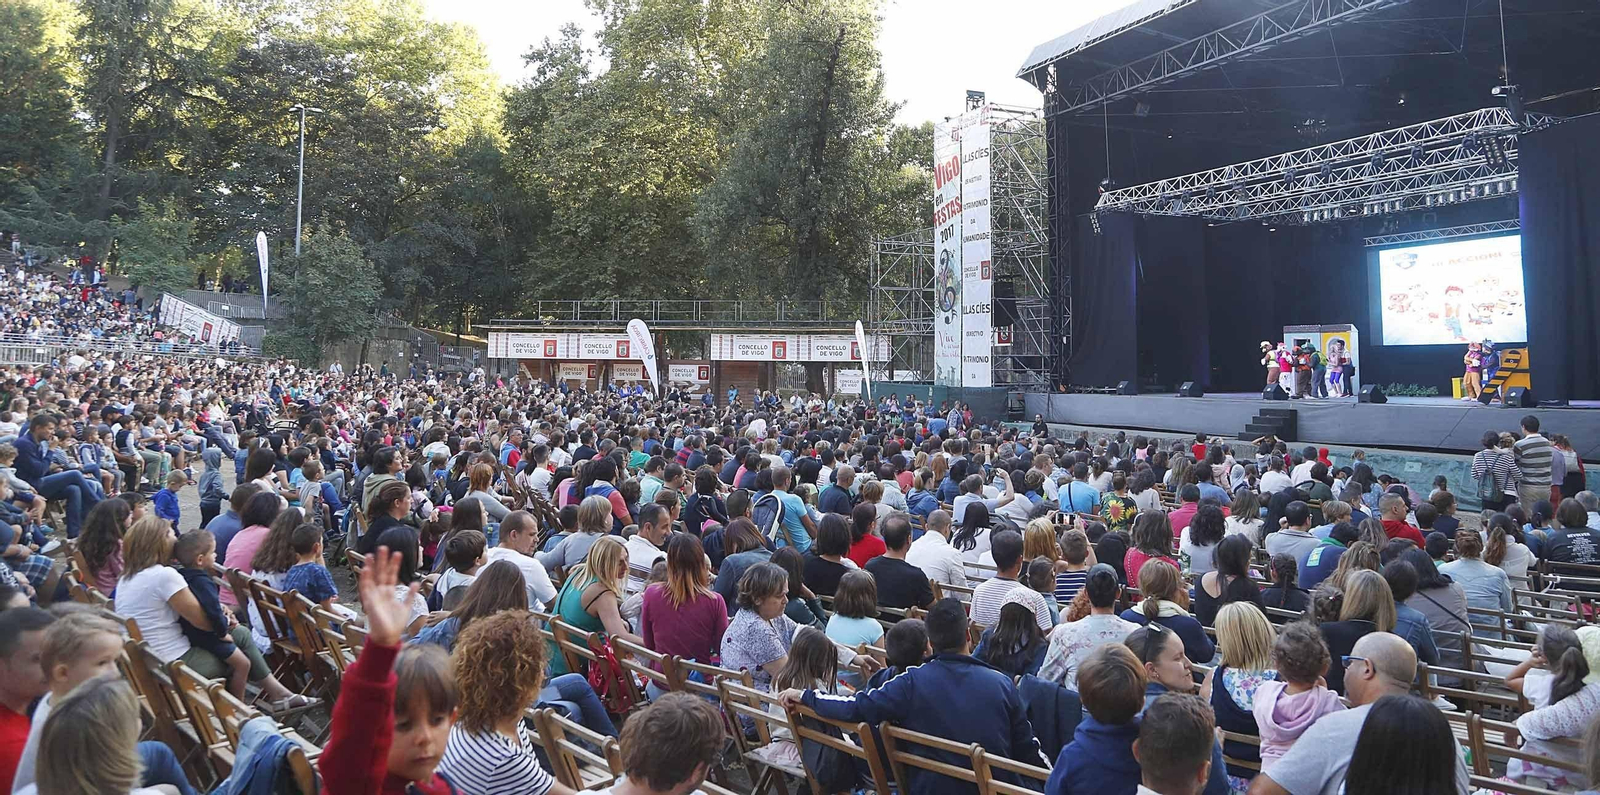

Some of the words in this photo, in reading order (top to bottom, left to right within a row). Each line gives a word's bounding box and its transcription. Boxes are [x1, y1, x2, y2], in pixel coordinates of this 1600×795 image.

[934, 155, 960, 190] VIGO
[936, 193, 944, 207] en
[934, 196, 962, 229] FESTAS
[940, 224, 954, 243] 2017
[963, 231, 990, 243] UMANIDADE
[975, 301, 990, 314] CÍES
